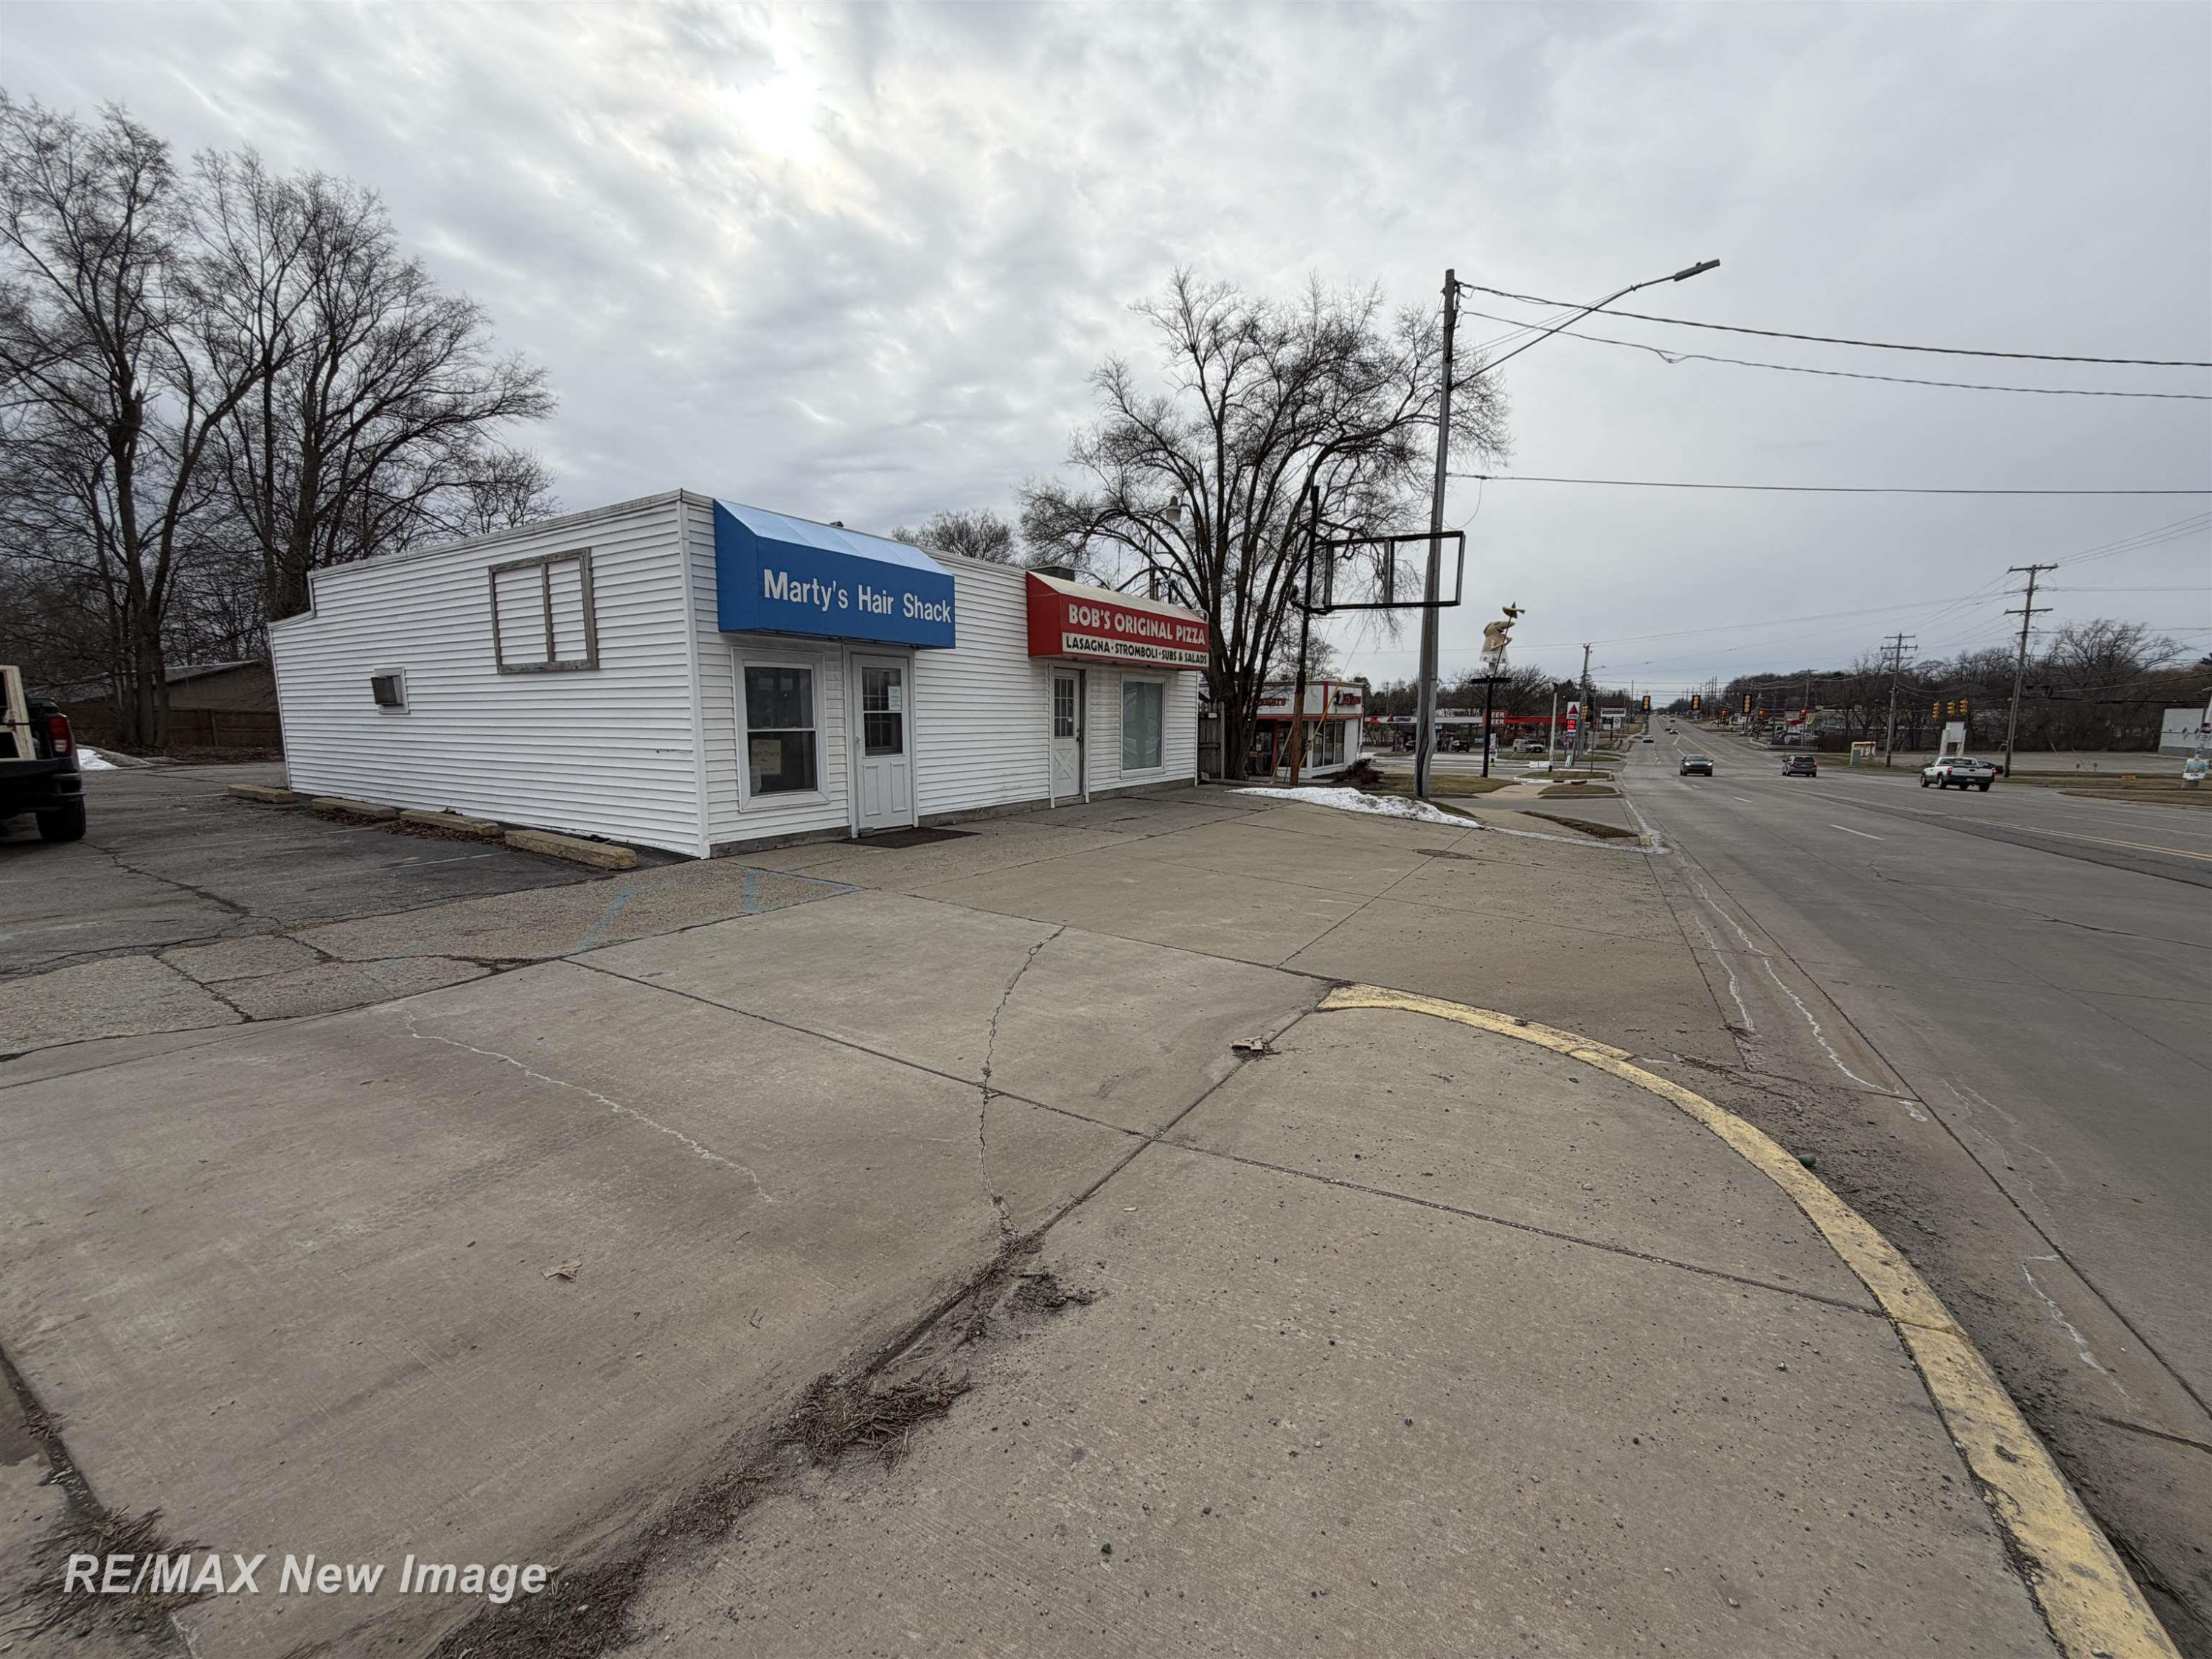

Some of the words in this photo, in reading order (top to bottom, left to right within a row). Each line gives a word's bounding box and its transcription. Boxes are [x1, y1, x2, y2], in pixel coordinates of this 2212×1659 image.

[764, 568, 848, 611] Marty's
[858, 585, 894, 614] Hair
[903, 593, 951, 623] Shack
[1069, 603, 1110, 629] BOB'S
[1114, 613, 1172, 639] ORIGINAL
[1176, 625, 1205, 644] PIZZA
[1066, 636, 1110, 653] LASAGNA
[1115, 642, 1158, 658] STROMBOLI
[1161, 650, 1177, 661] SUBS
[1178, 652, 1183, 661] &
[1184, 653, 1207, 664] SALADS
